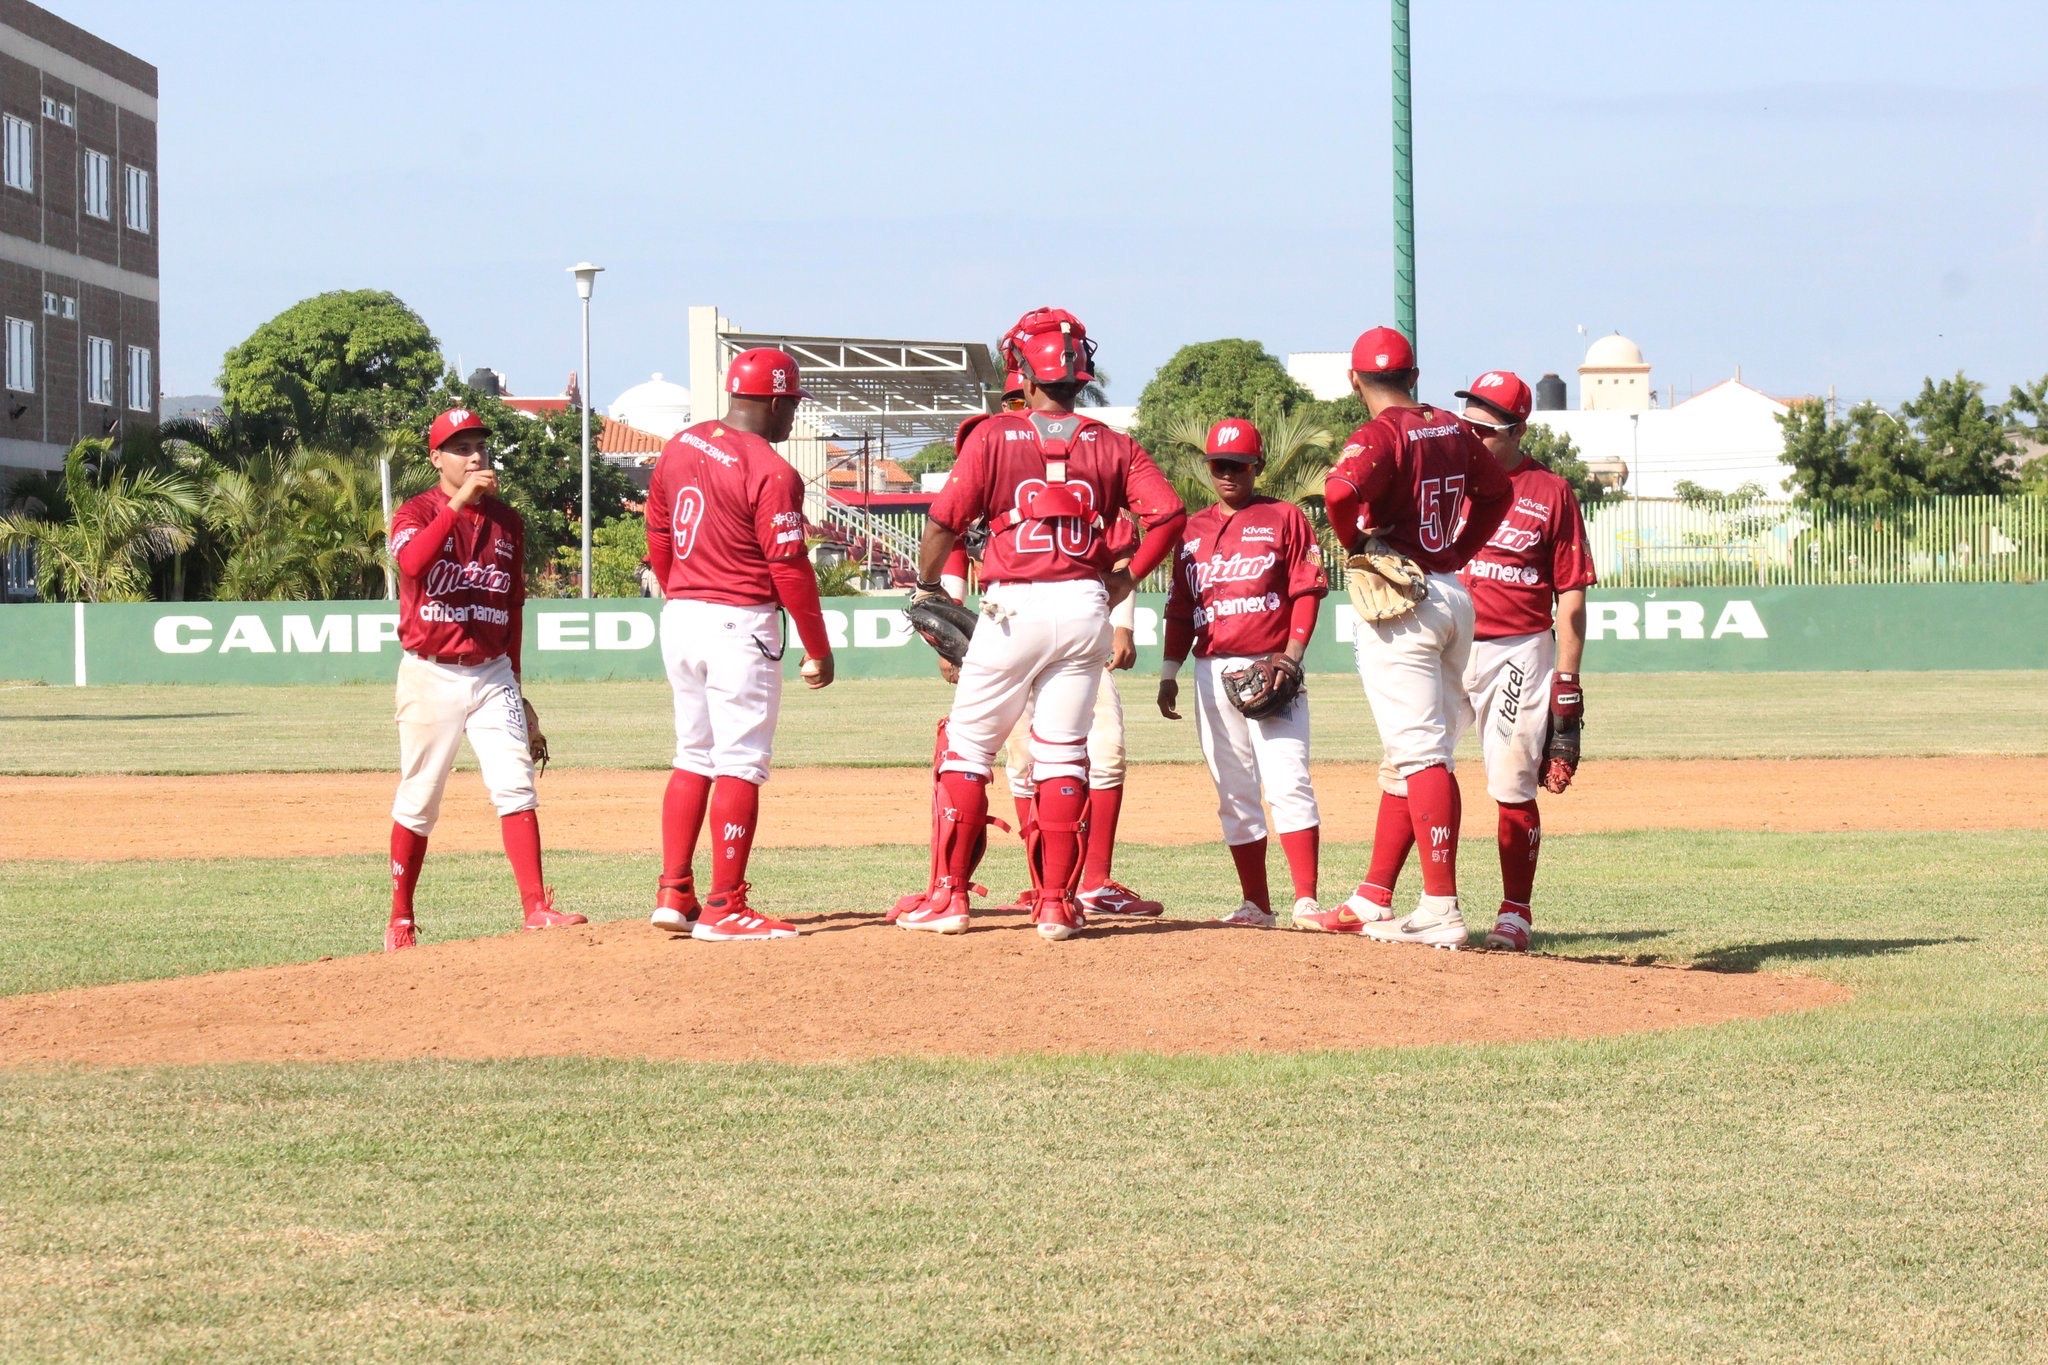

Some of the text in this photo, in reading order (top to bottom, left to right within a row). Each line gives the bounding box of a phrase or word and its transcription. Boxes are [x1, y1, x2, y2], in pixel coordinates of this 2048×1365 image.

[732, 377, 740, 392] 9
[673, 486, 704, 560] 9
[1420, 474, 1466, 552] 57
[154, 614, 401, 653] CAMP
[1499, 660, 1525, 724] telcel
